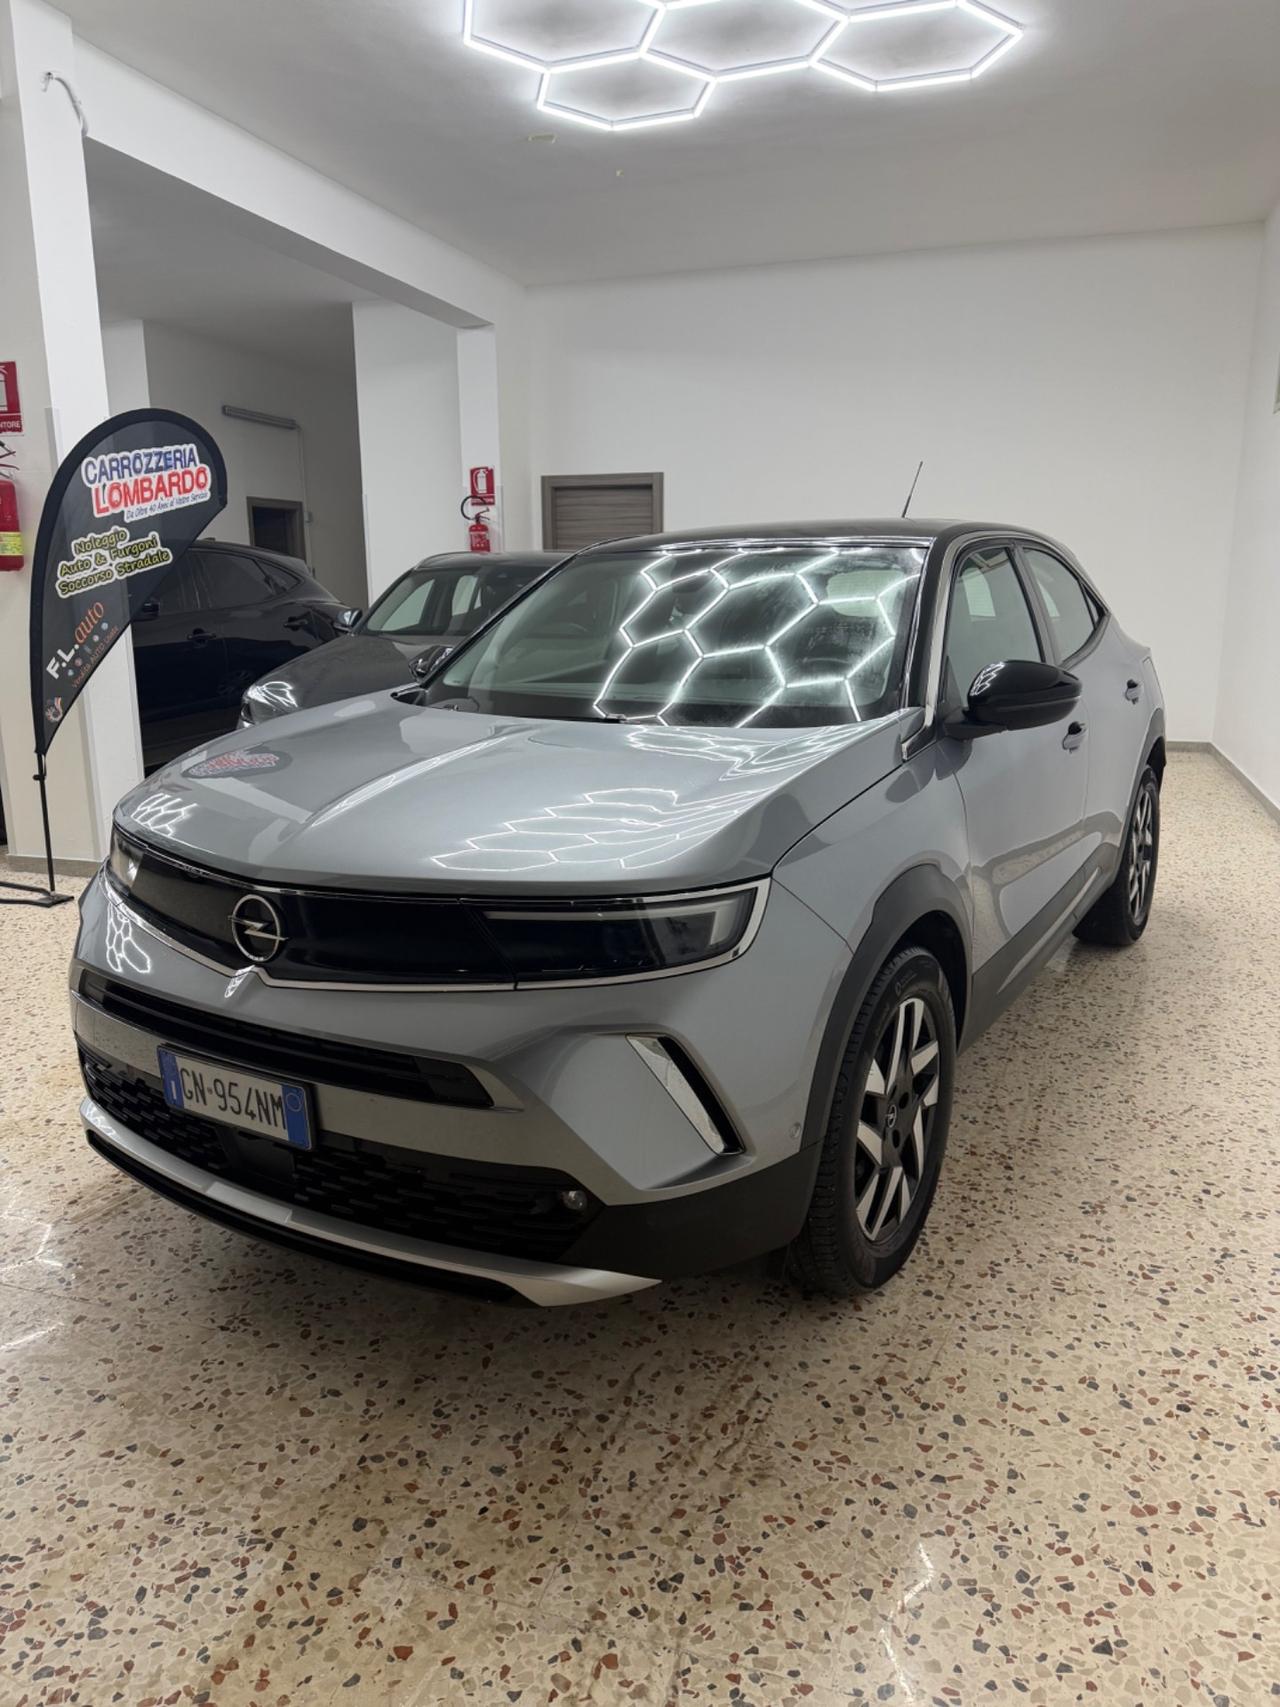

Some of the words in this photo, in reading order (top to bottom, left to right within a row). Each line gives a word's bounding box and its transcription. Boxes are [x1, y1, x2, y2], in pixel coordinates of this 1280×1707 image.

[85, 445, 198, 484] CARROZZERIA
[149, 503, 157, 513] 40
[60, 559, 91, 577] Auto
[94, 552, 107, 567] &
[110, 535, 158, 560] Furgoni
[74, 528, 126, 554] Noleggio
[59, 569, 113, 594] Soccorso
[115, 550, 170, 576] Stradale
